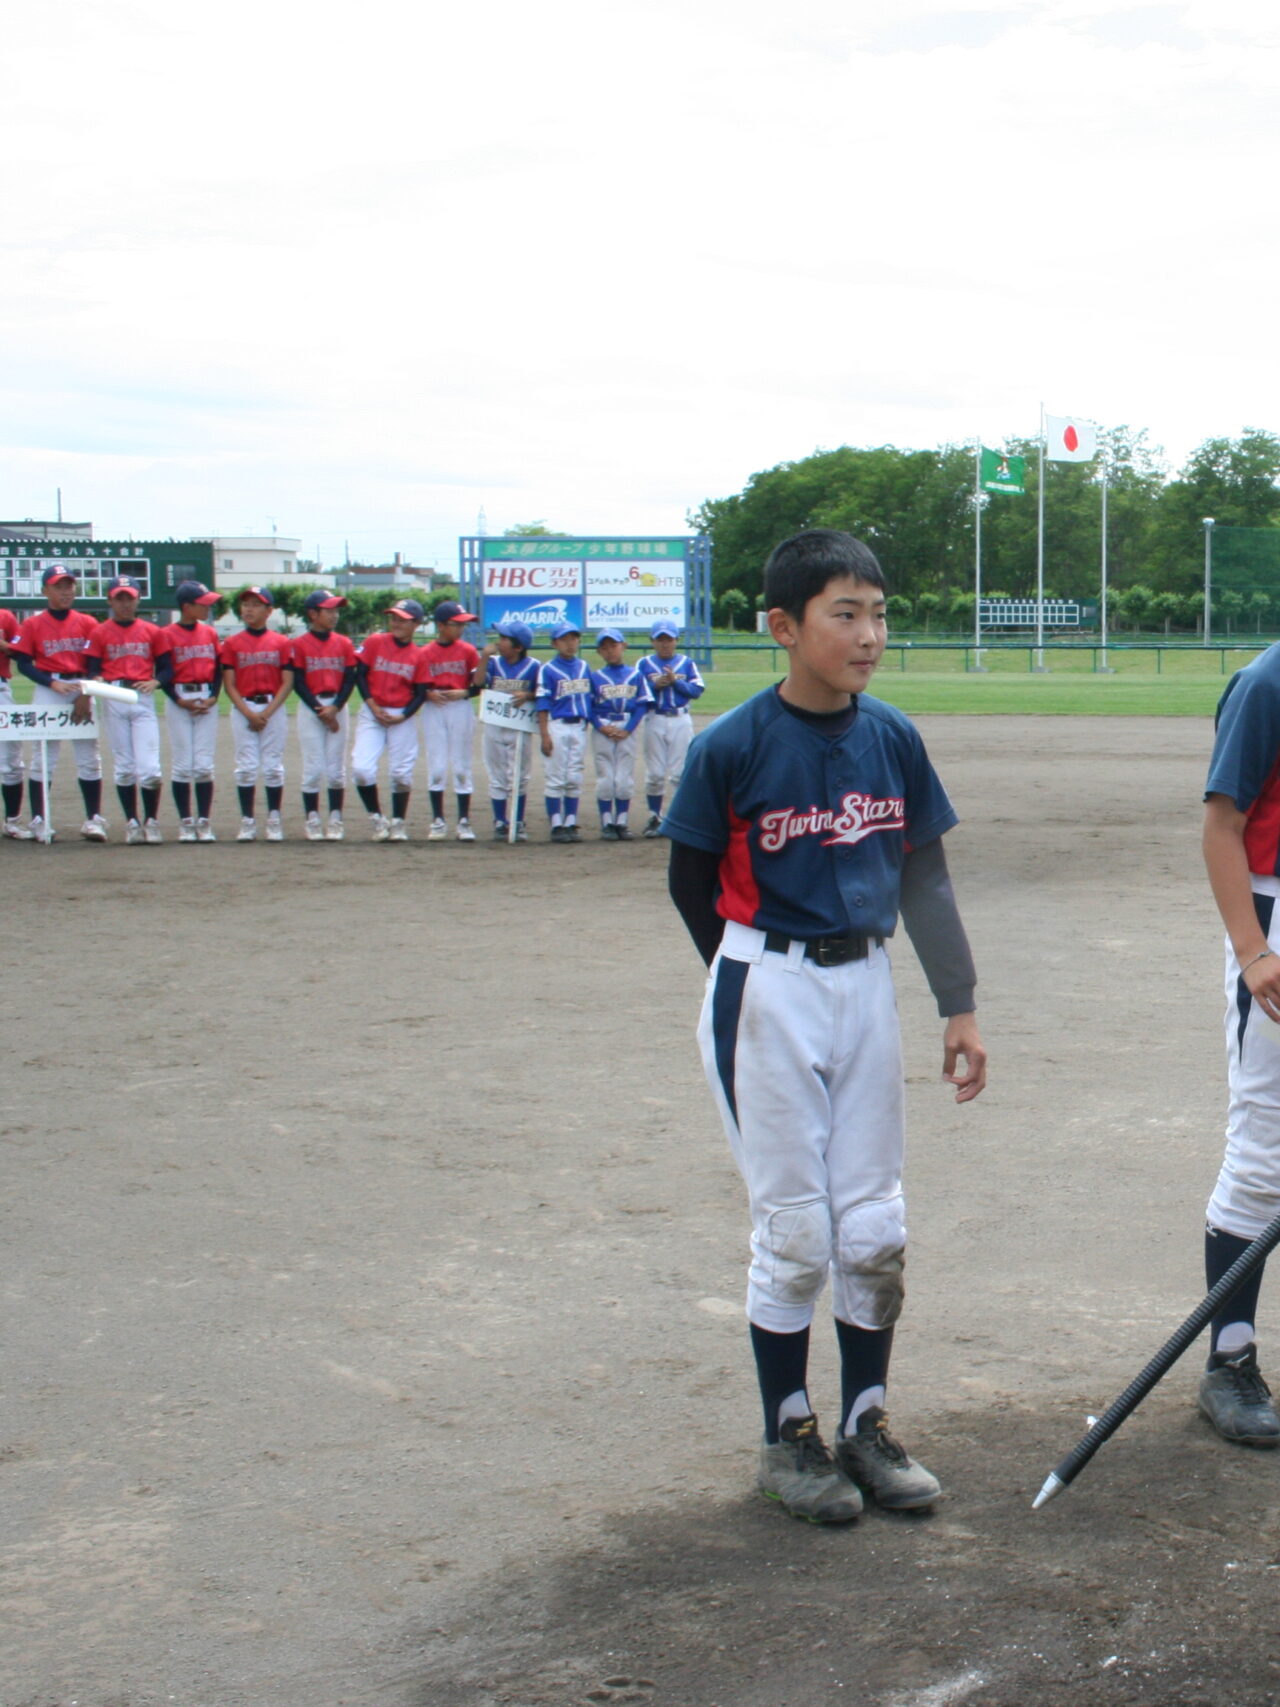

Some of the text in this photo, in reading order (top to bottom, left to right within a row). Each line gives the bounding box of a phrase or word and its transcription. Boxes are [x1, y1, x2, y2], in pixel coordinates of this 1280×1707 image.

[487, 567, 579, 588] HBC テレビ
[628, 566, 640, 580] 6
[657, 577, 684, 587] HTB
[500, 609, 567, 625] AQUARIUS
[589, 601, 669, 617] Asahi CALPIS
[486, 700, 540, 724] 中の島ファイ
[760, 793, 904, 851] Twin Star
